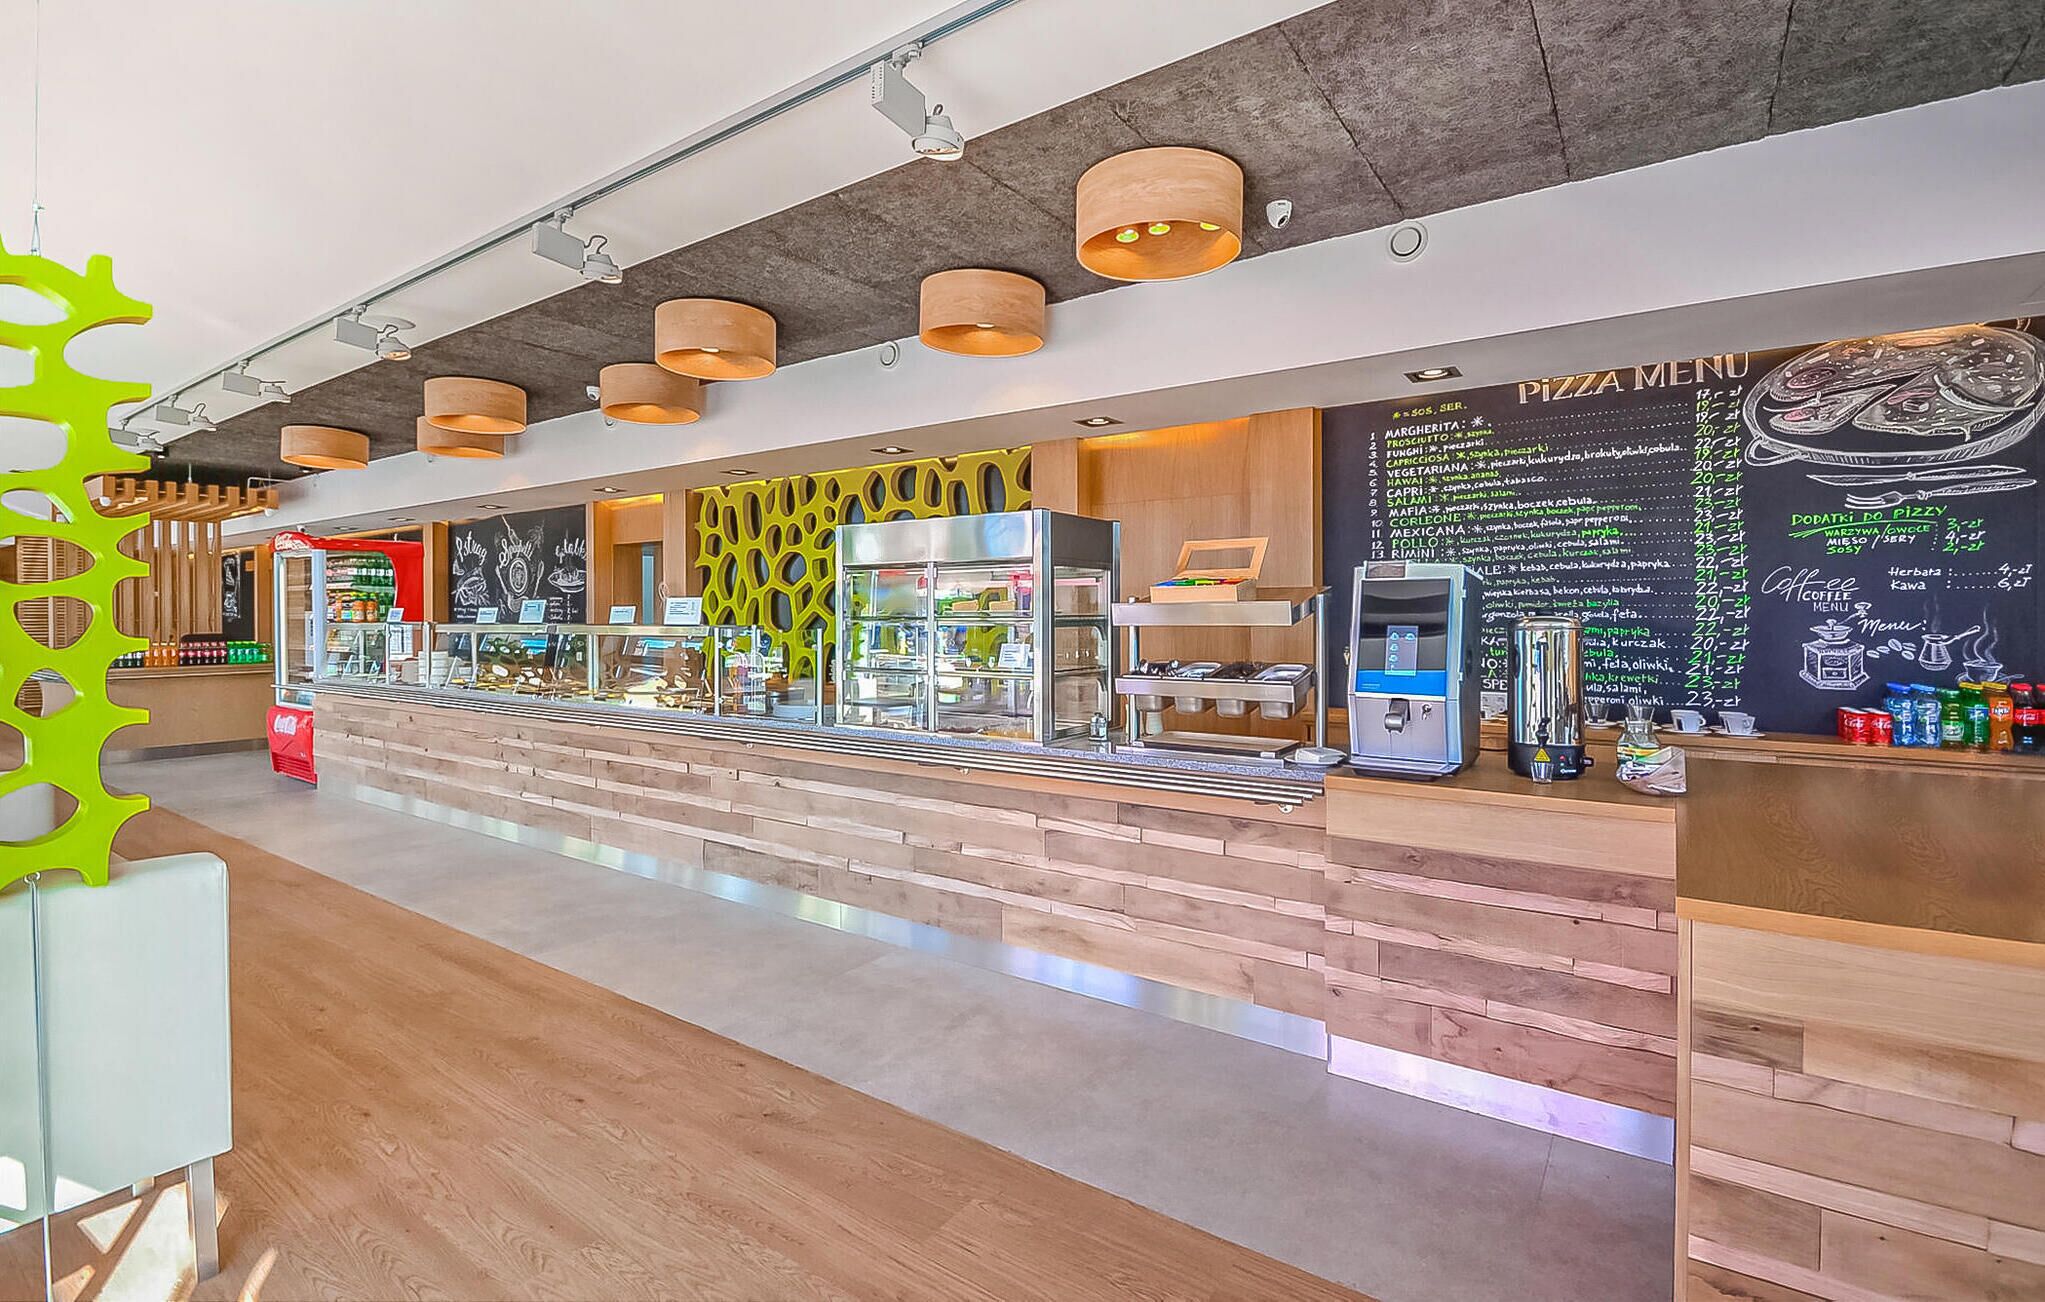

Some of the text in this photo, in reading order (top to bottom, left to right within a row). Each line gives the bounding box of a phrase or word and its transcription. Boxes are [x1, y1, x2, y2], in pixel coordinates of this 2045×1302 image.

[1633, 351, 1749, 391] MENU
[1863, 511, 1883, 522] DO
[1826, 545, 1862, 555] SOSY
[1761, 566, 1860, 602] Coffee
[1890, 579, 1926, 591] Kawa
[1813, 602, 1849, 612] MENU
